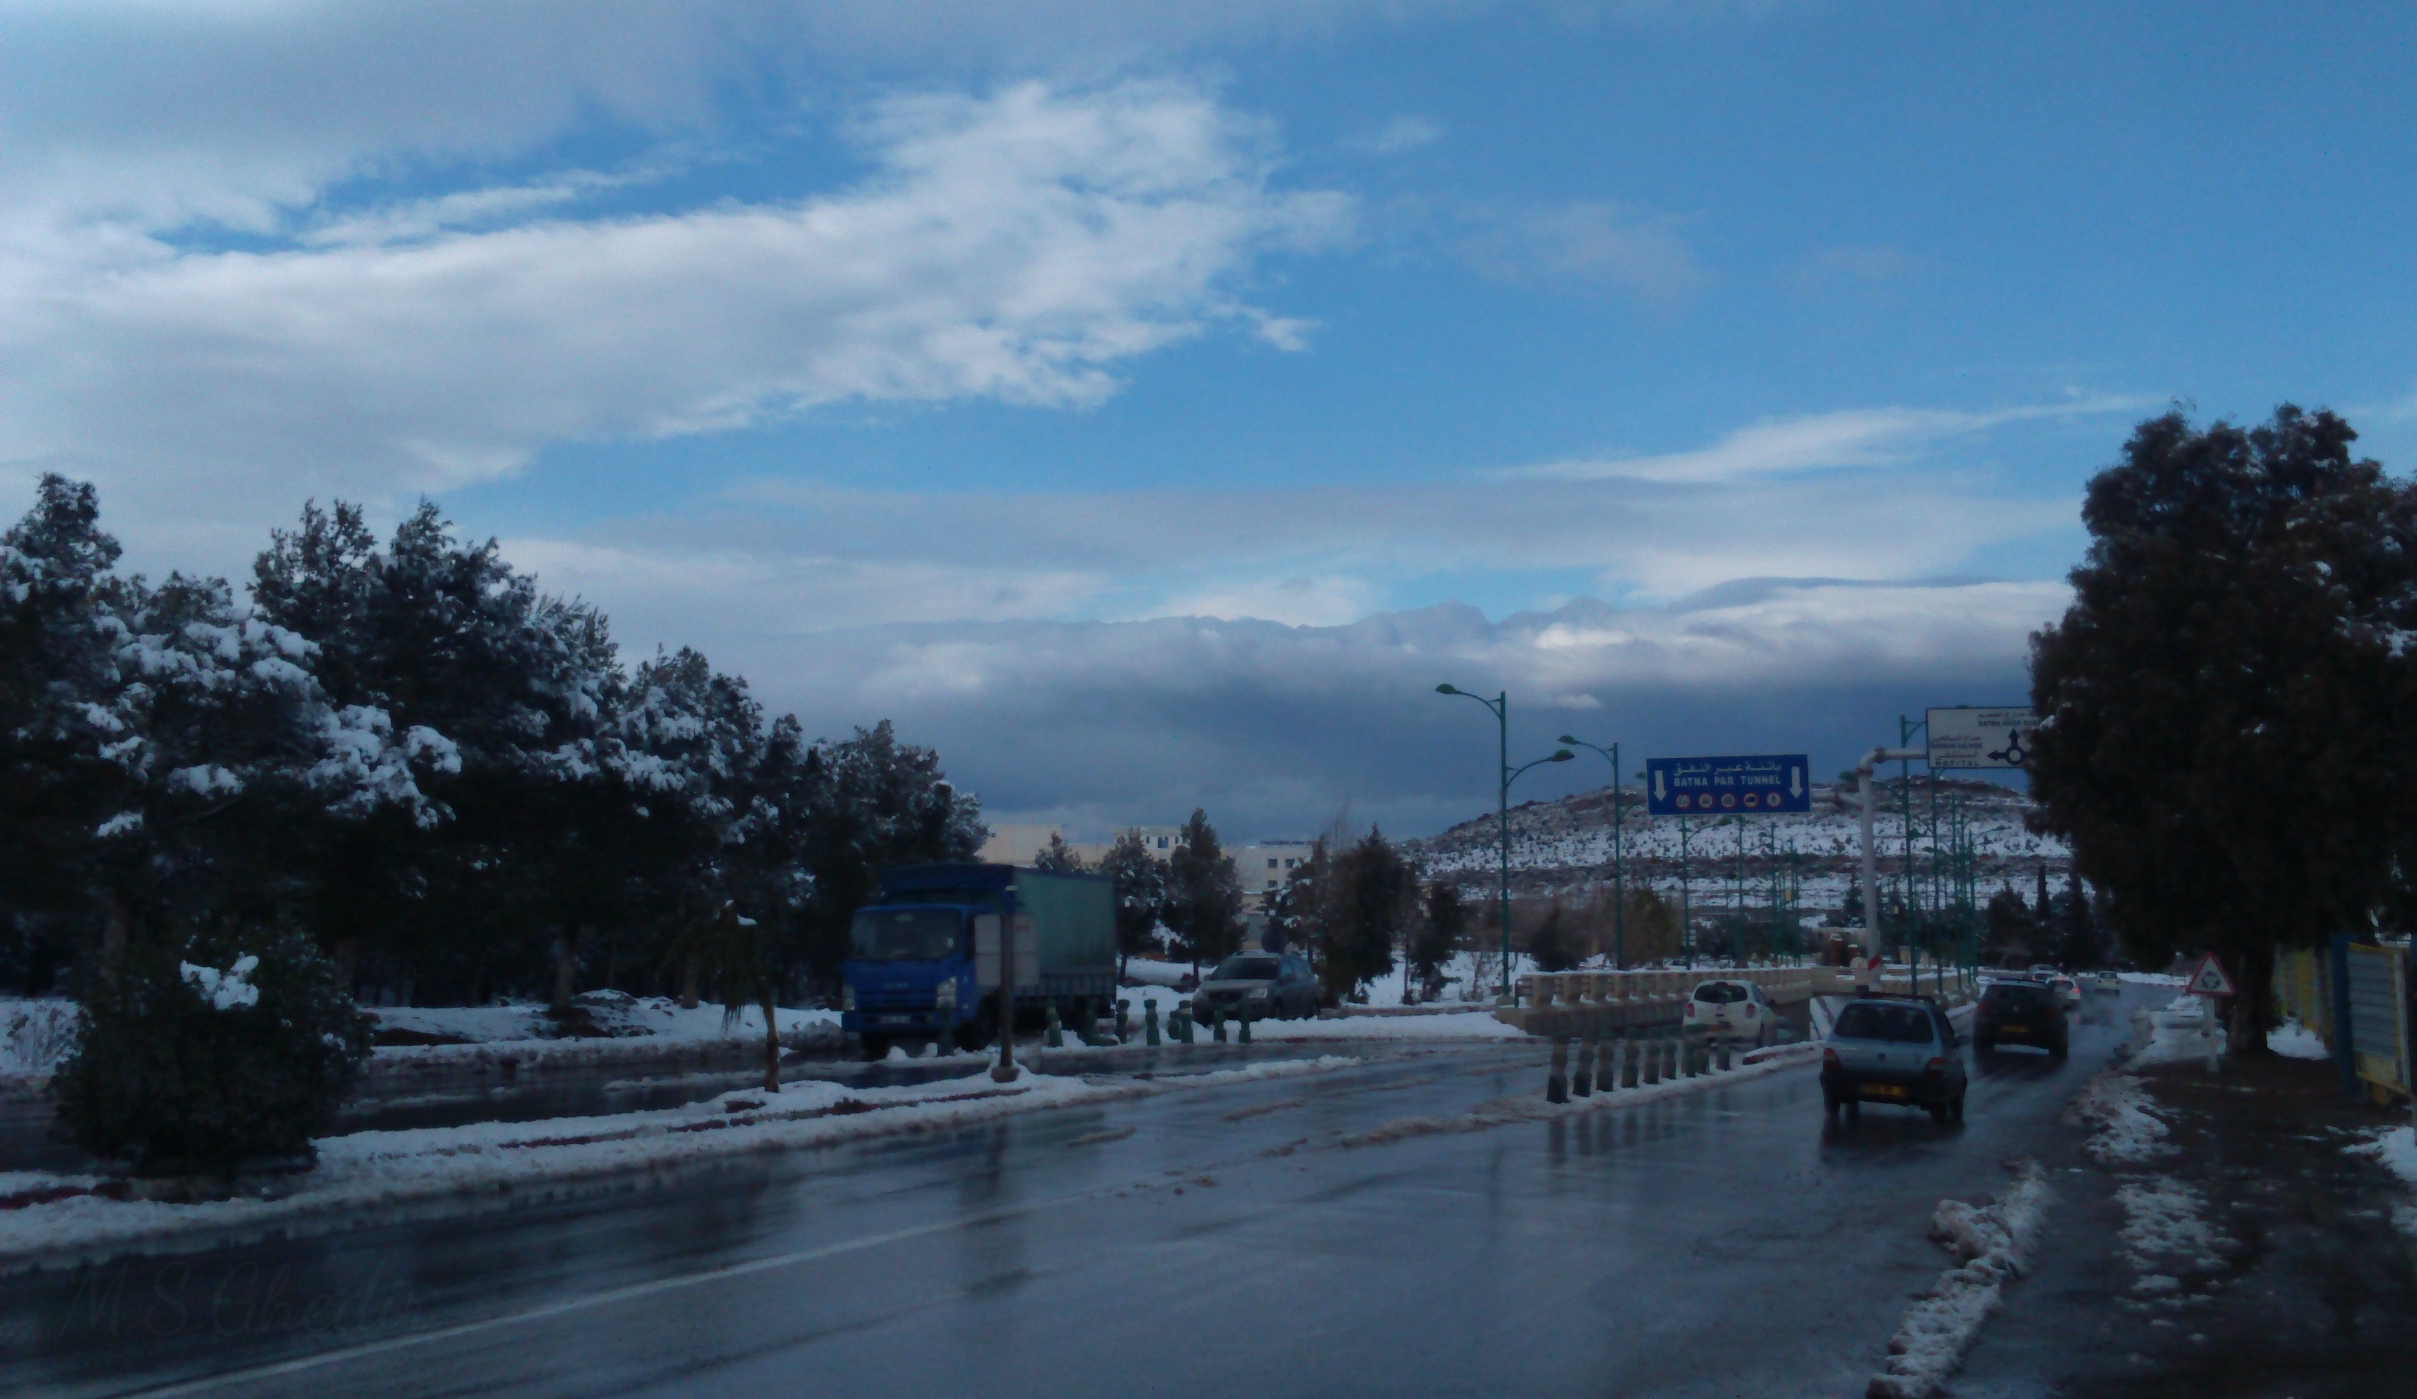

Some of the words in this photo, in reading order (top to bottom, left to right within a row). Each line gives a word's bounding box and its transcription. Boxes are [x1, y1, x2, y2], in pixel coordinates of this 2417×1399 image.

[1673, 762, 1711, 777] النفق
[1674, 776, 1709, 787] BATNA
[1714, 775, 1734, 786] PAR
[1740, 775, 1781, 785] TUNNEL
